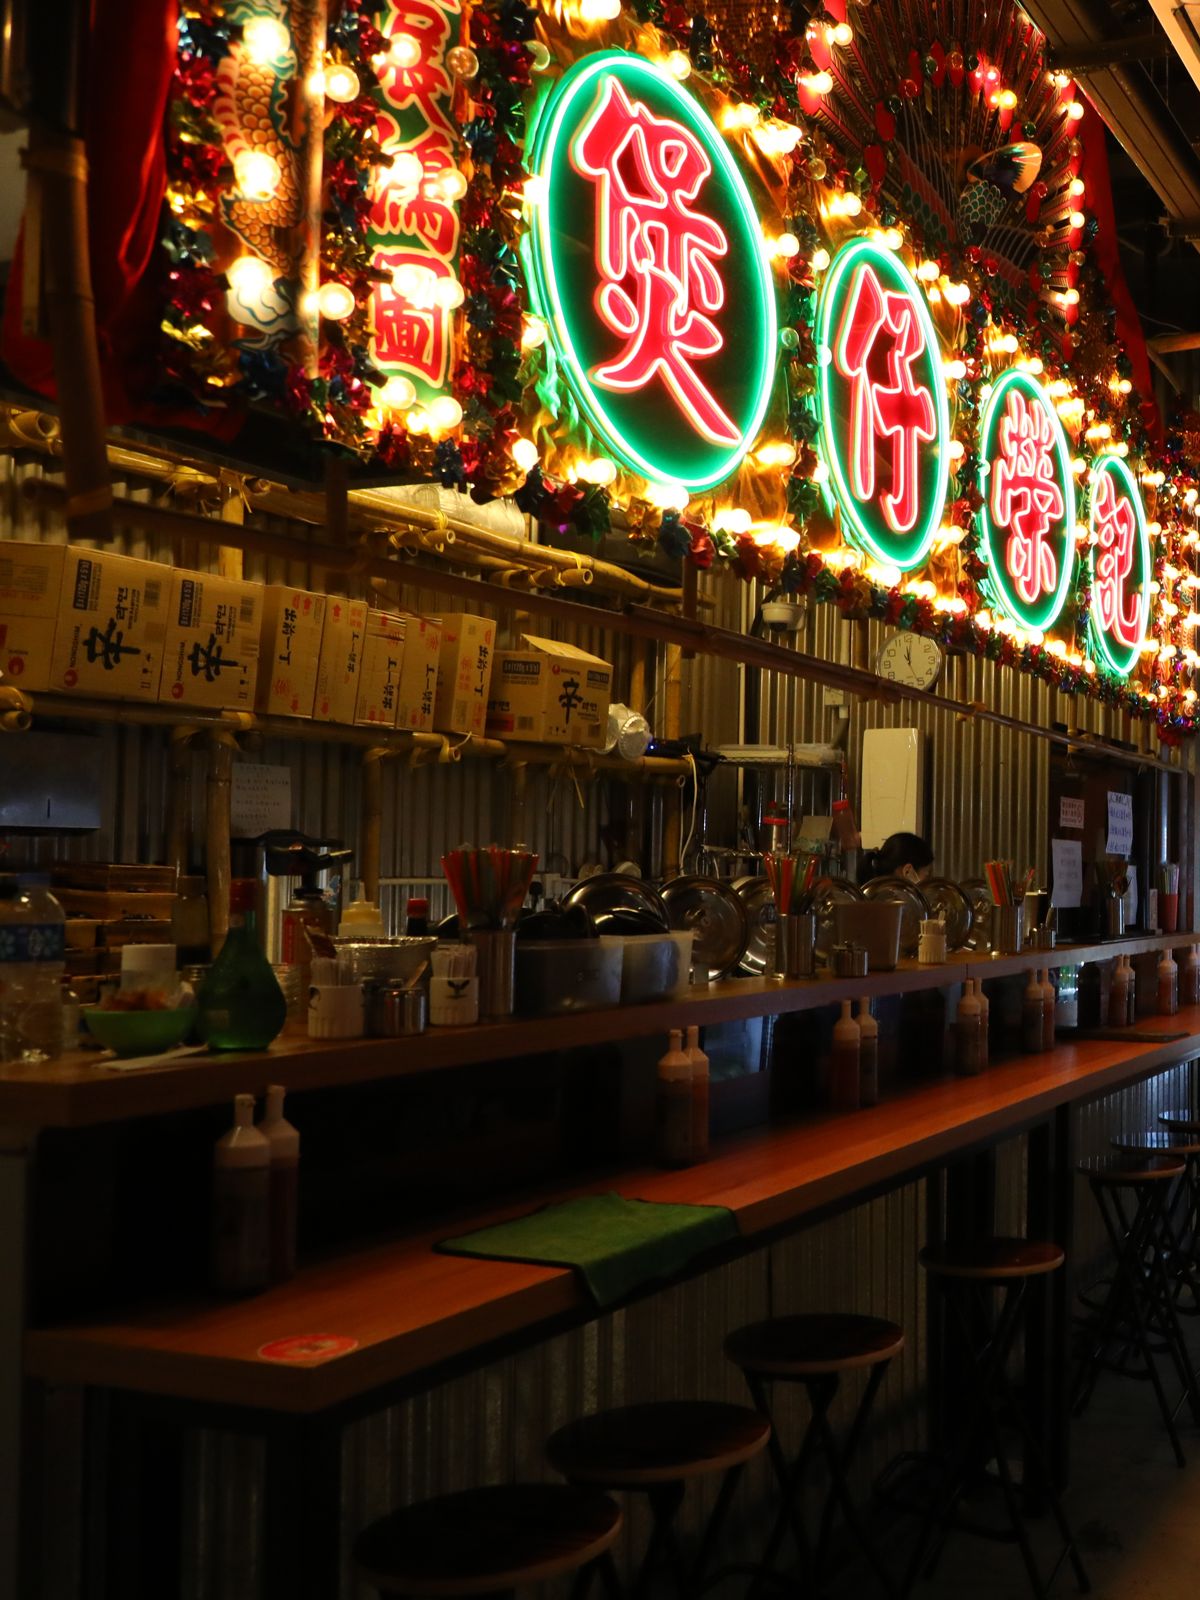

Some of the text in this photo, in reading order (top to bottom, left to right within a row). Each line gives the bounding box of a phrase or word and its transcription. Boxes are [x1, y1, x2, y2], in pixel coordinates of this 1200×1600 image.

[83, 618, 140, 670] 辛
[187, 633, 239, 683] 辛
[279, 607, 297, 666] 出前一丁
[383, 656, 397, 710] 出前一丁
[421, 663, 435, 715] 出前一丁
[474, 644, 488, 697] 出前一丁
[559, 677, 584, 724] 辛
